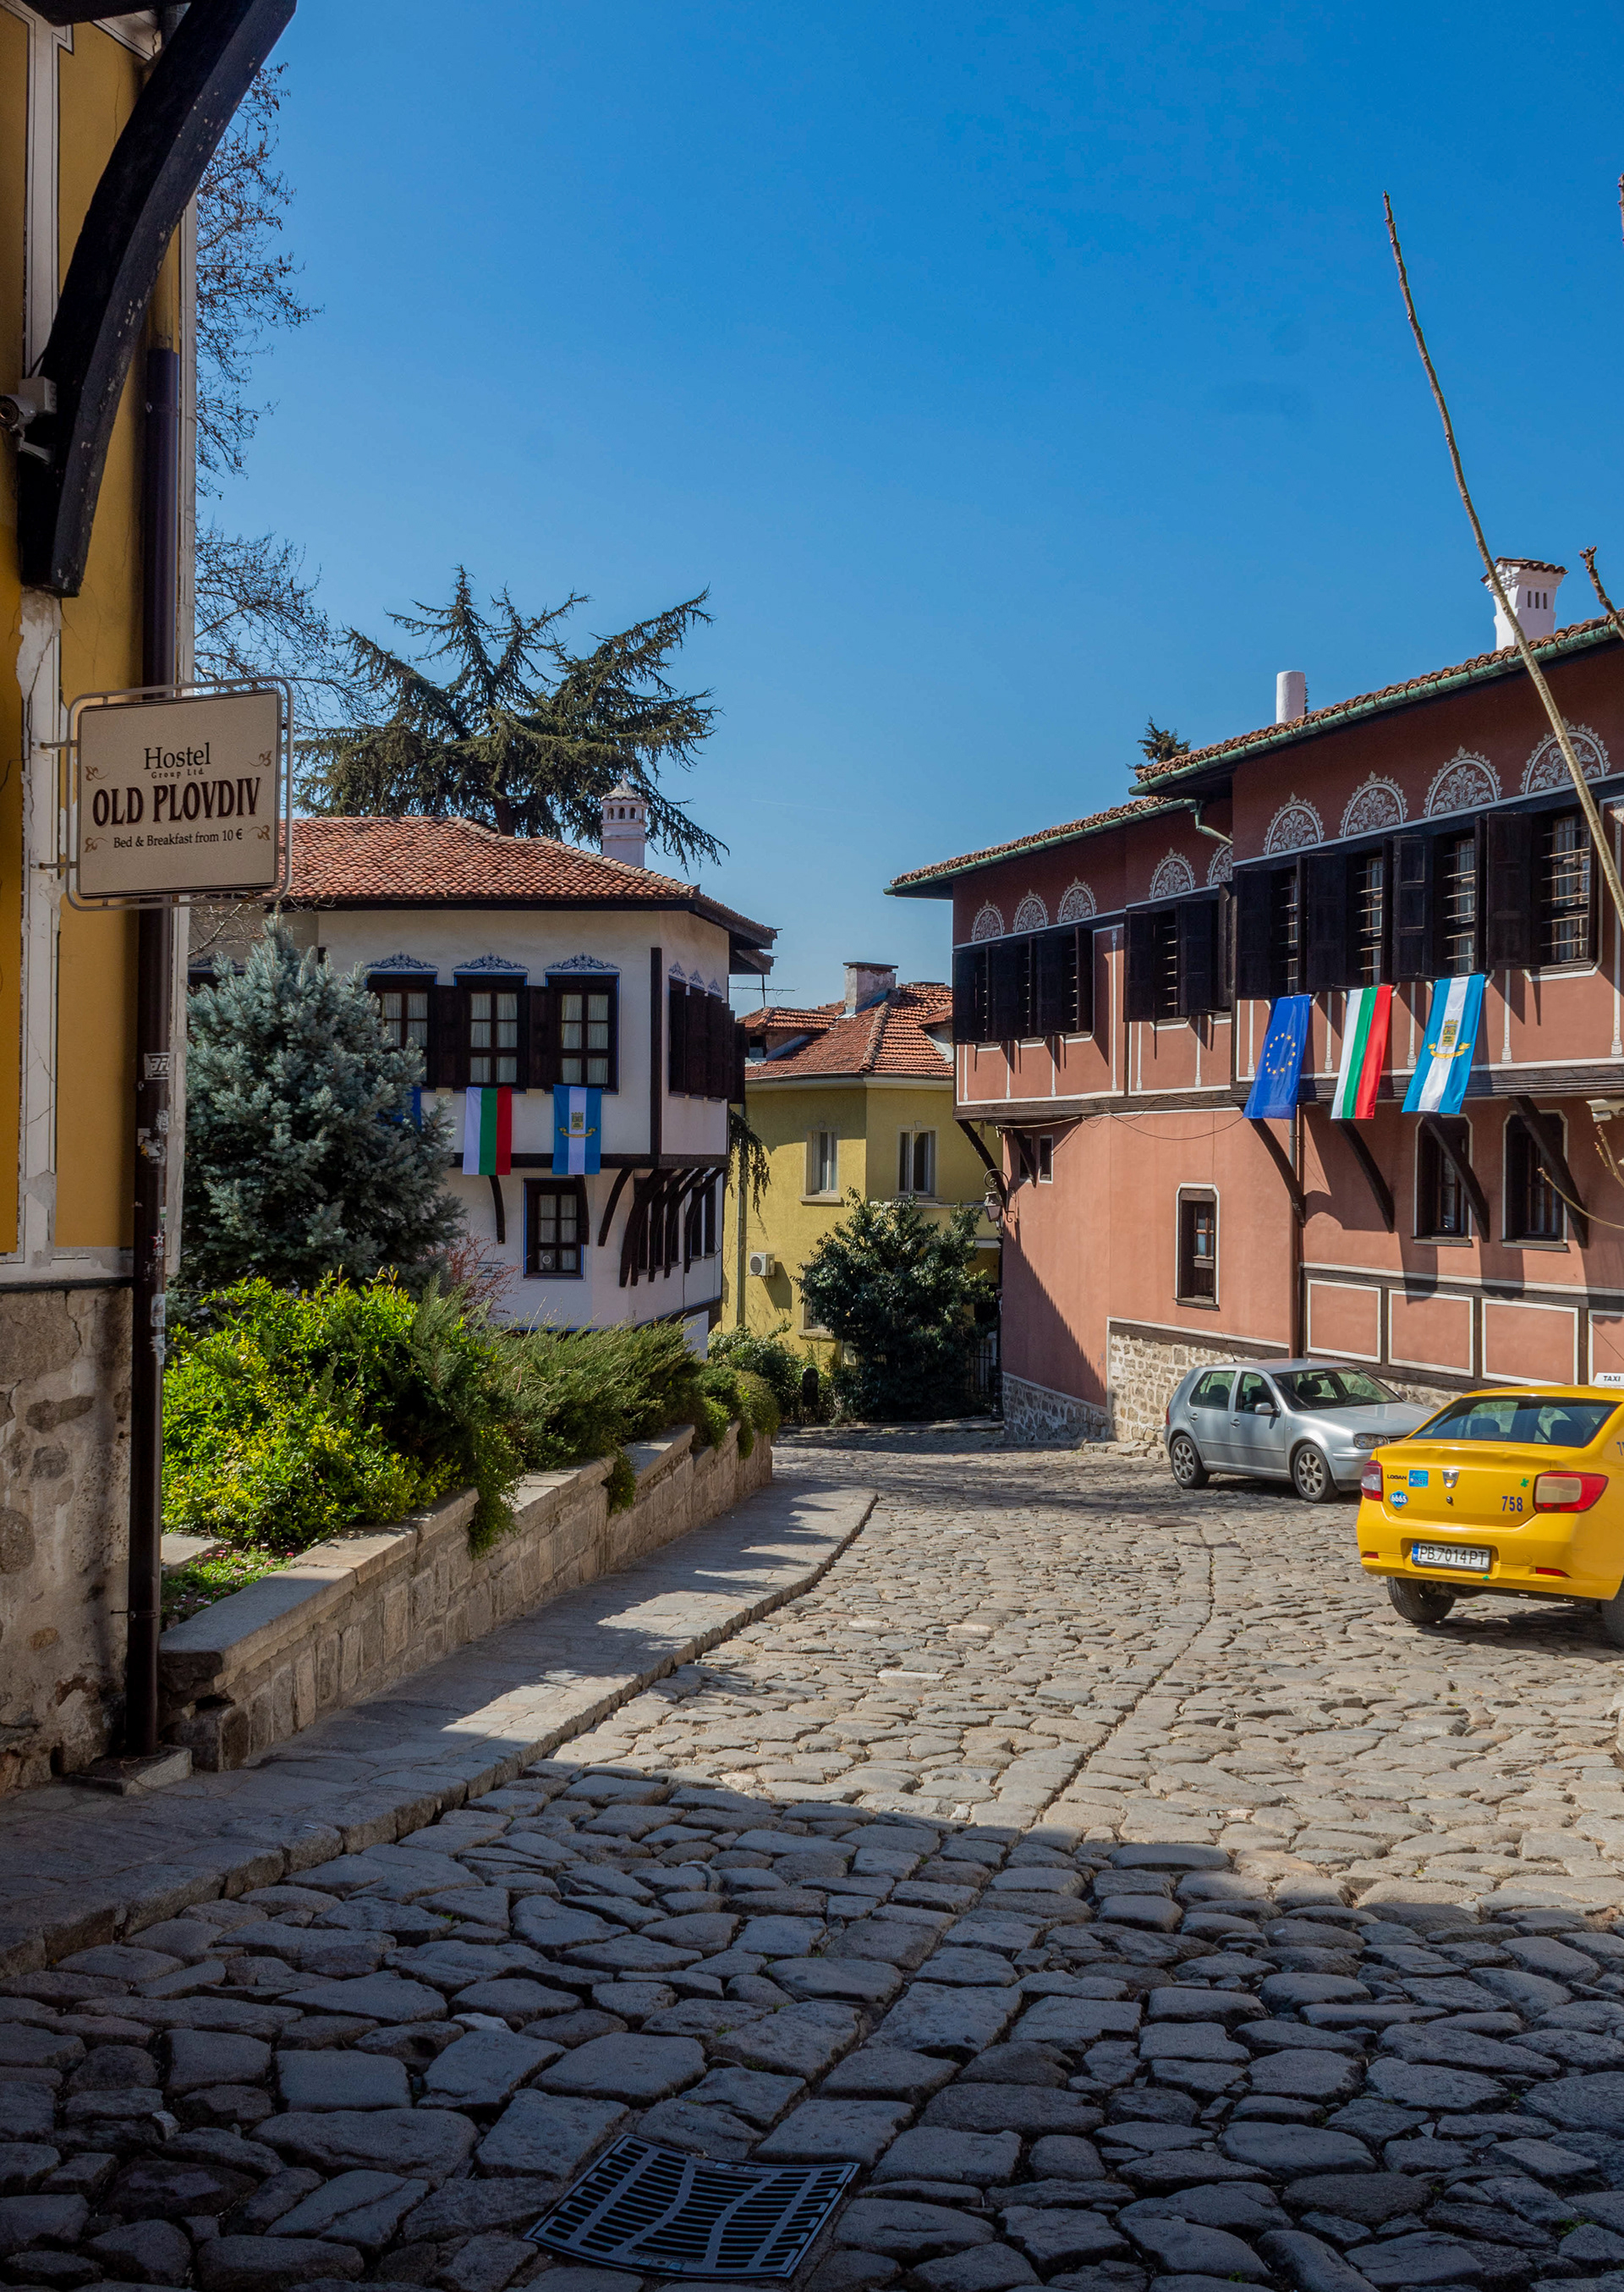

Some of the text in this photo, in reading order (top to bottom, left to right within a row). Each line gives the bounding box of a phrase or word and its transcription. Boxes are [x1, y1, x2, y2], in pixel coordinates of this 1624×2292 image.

[144, 742, 211, 770] Hostel
[151, 771, 182, 779] Group
[92, 777, 261, 827] OLD PLOVDIV
[113, 828, 244, 849] Bed & Breakfast from 10 €
[1501, 1495, 1523, 1512] 758
